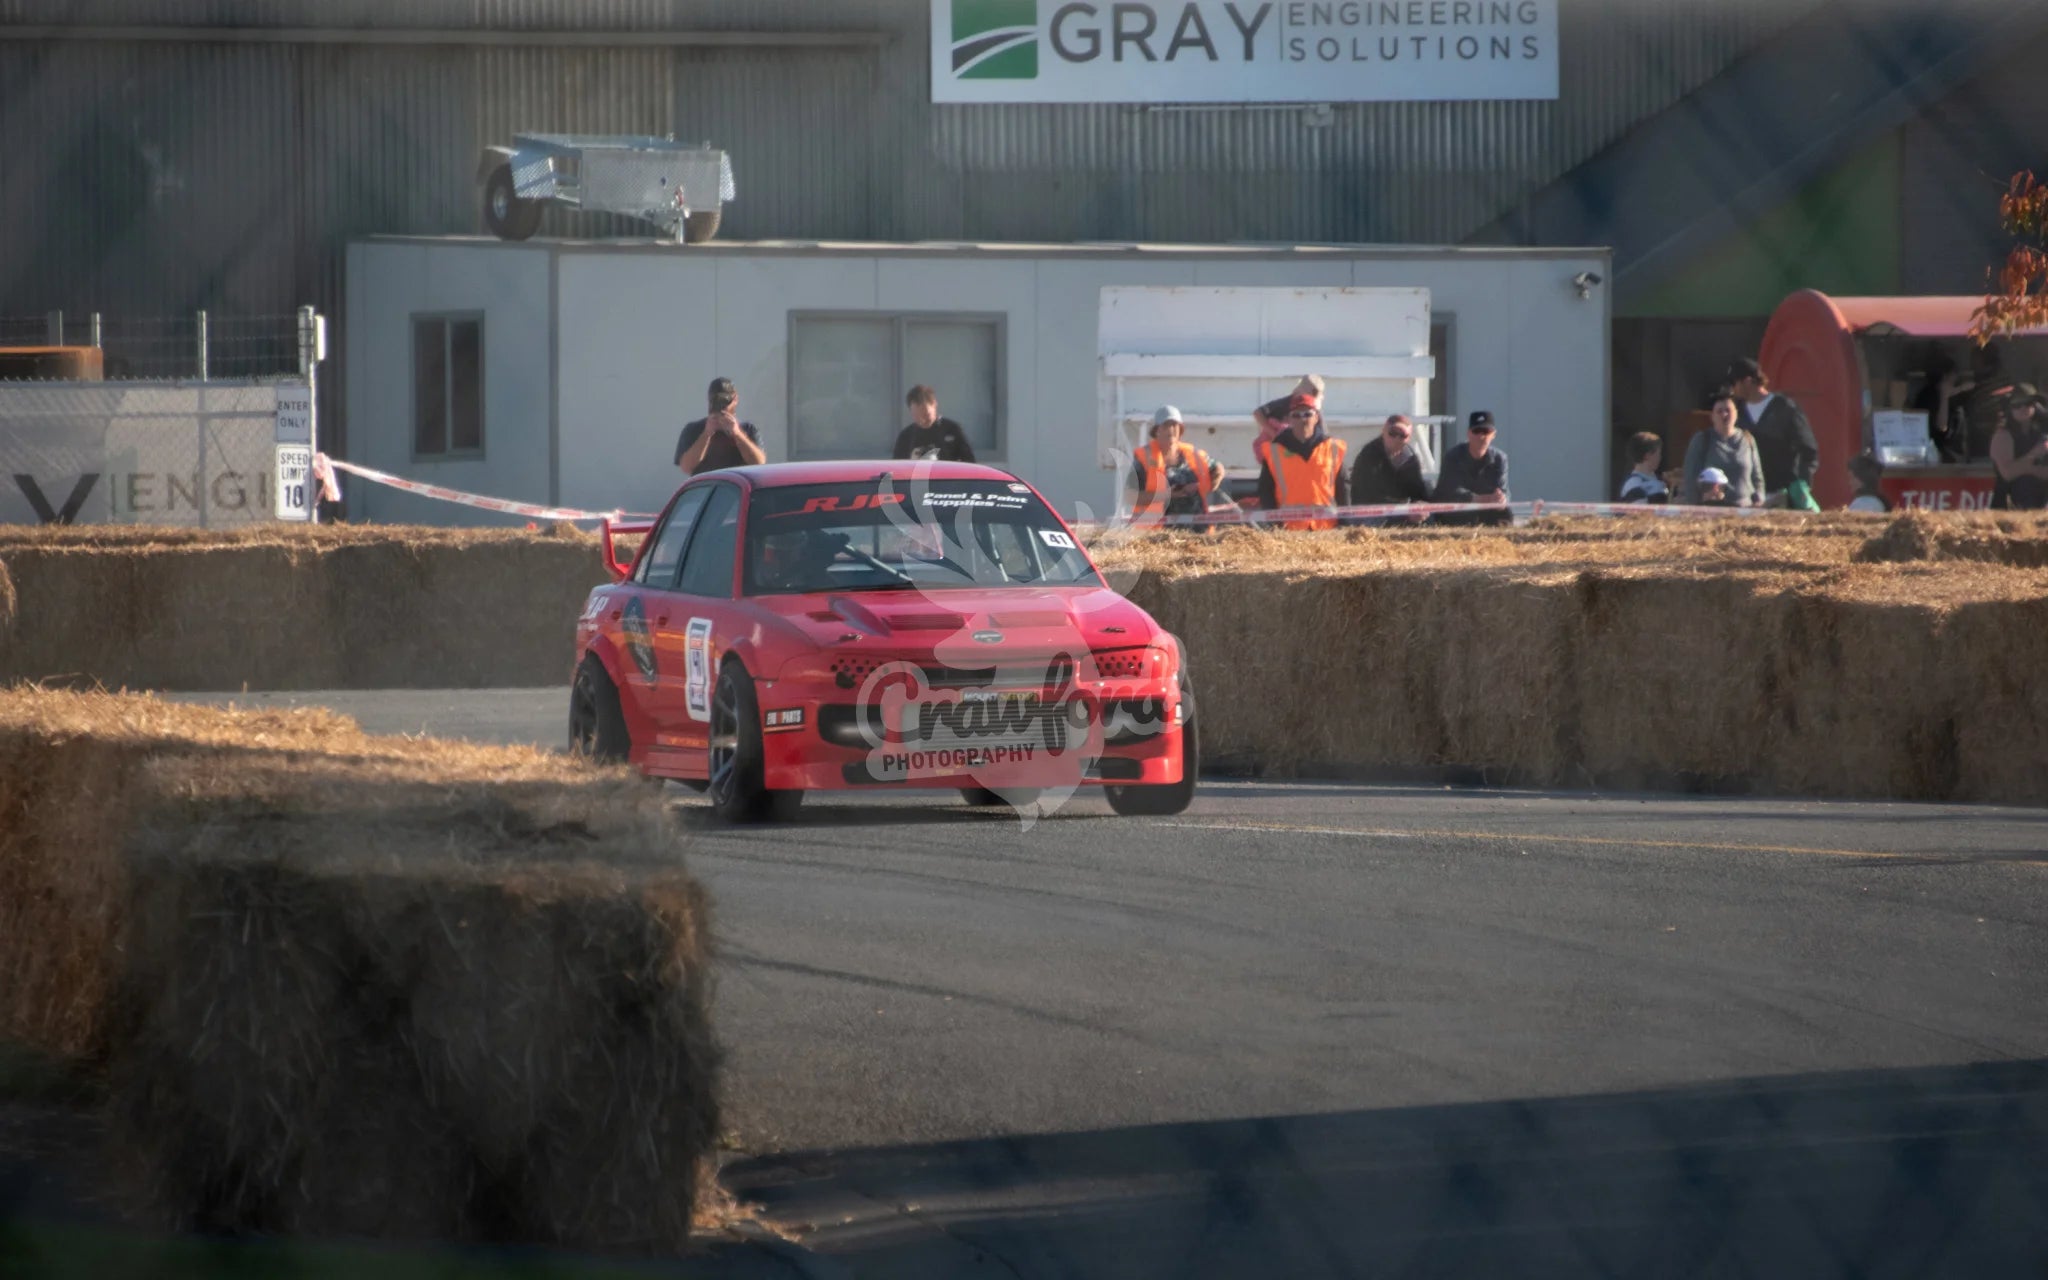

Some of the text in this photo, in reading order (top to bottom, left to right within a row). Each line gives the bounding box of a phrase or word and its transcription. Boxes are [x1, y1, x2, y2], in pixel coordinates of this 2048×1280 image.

[1288, 1, 1538, 26] ENGINEERING
[1049, 2, 1273, 63] GRAY
[1289, 36, 1538, 62] SOLUTIONS
[278, 401, 308, 411] ENTER
[280, 418, 306, 428] ONLY
[280, 452, 308, 465] SPEED
[282, 467, 306, 480] LIMIT
[285, 485, 304, 508] 10
[922, 498, 995, 508] Supplies
[923, 492, 967, 500] Panel
[987, 493, 1028, 503] Paint
[1902, 490, 1952, 511] THE
[1050, 533, 1068, 545] 41
